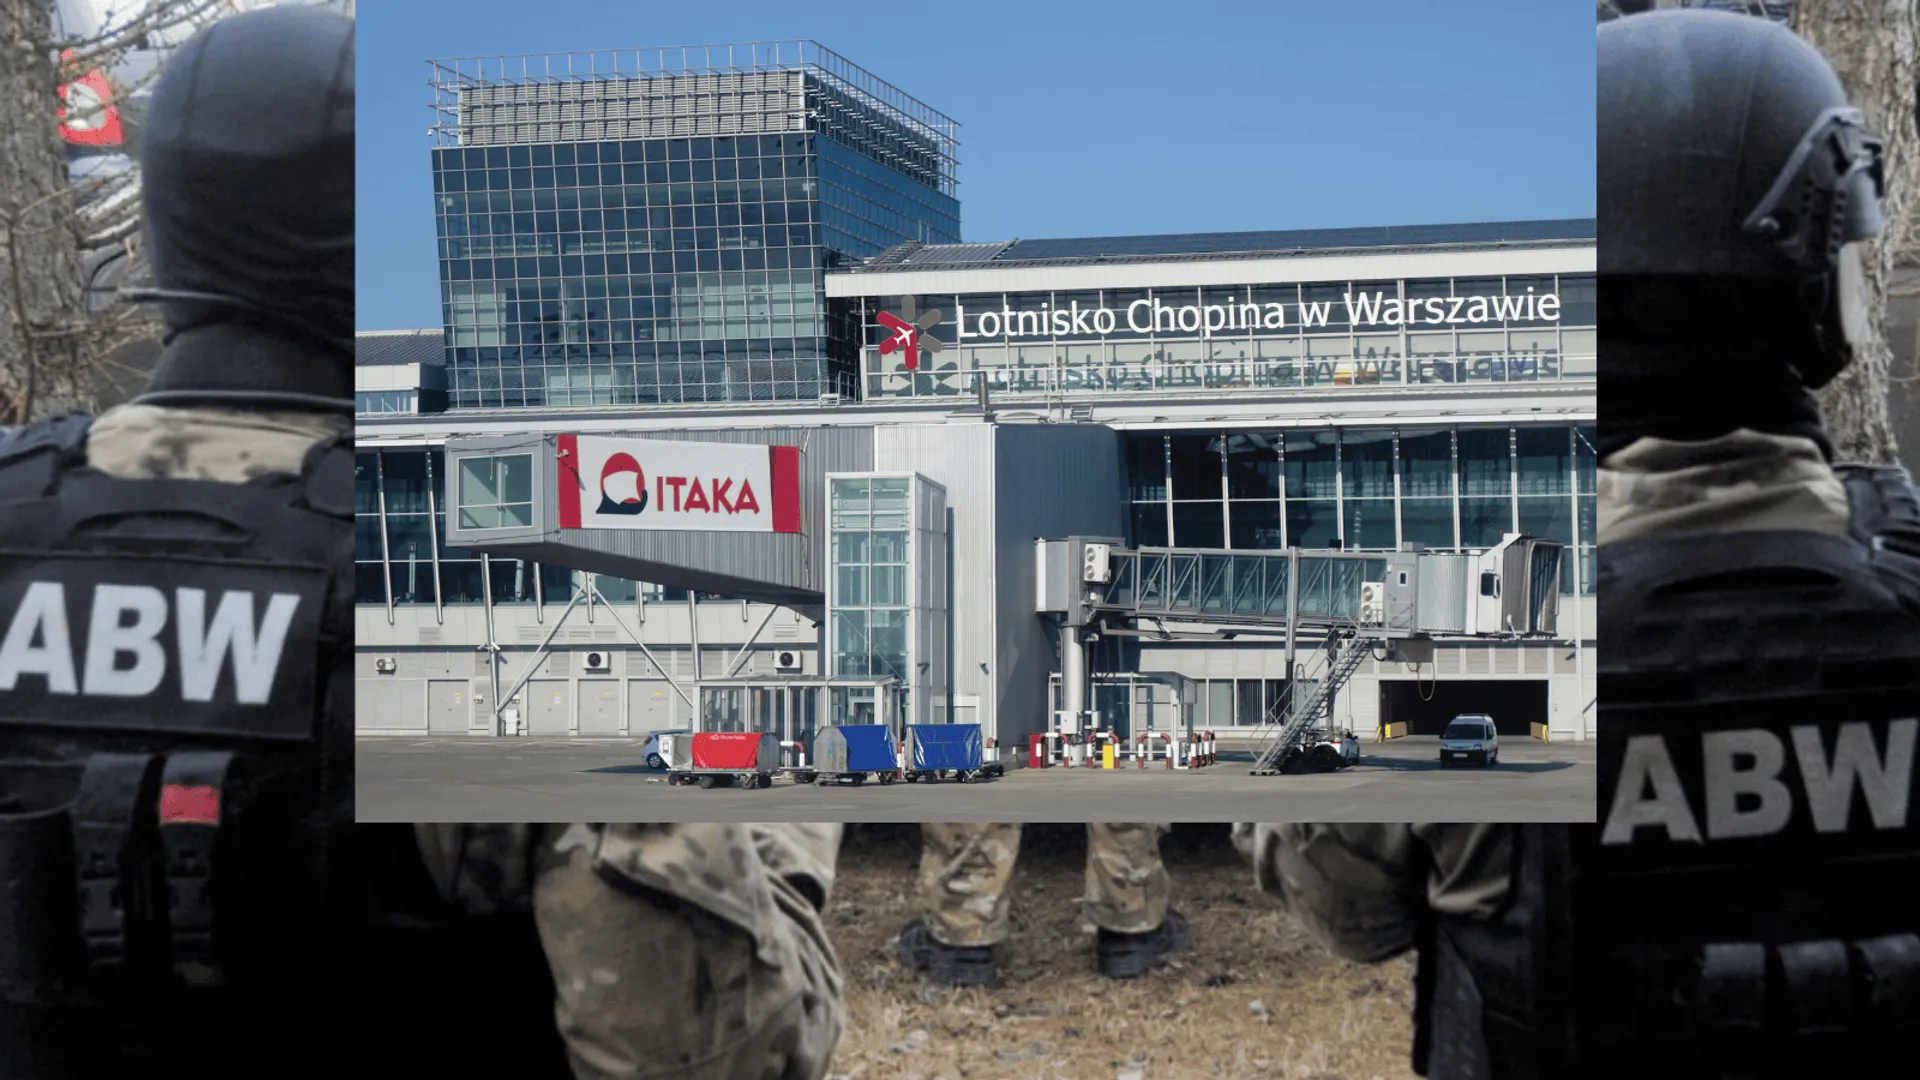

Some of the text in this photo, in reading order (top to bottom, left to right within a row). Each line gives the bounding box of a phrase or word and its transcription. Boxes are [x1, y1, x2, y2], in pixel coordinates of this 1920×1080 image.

[957, 286, 1561, 339] Lotnisko Chopina w Warszawie
[656, 476, 761, 515] ITAKA
[0, 581, 301, 704] ABW
[1601, 718, 1919, 845] ABW
